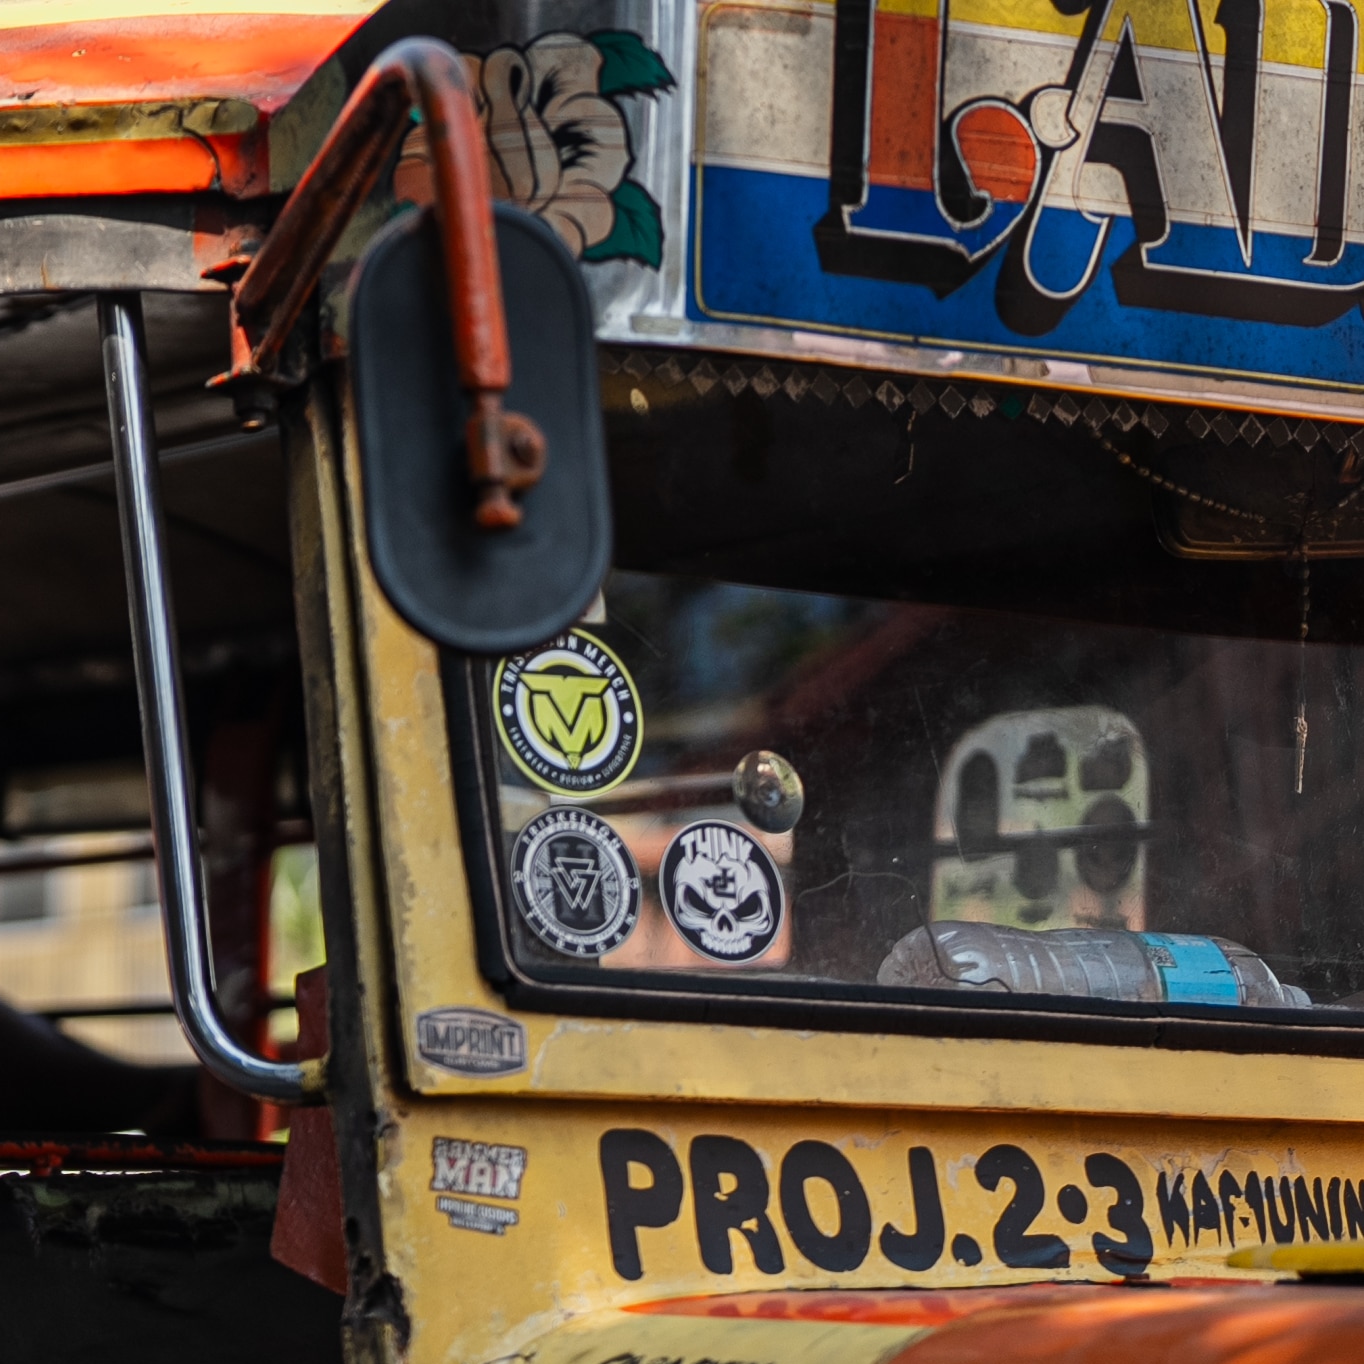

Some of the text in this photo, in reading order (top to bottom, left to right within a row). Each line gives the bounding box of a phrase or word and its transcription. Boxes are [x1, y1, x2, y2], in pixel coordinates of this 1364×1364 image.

[583, 643, 630, 702] MERCH
[680, 827, 754, 866] THINK
[426, 1021, 518, 1057] IMPRINT
[432, 1157, 521, 1199] MAN
